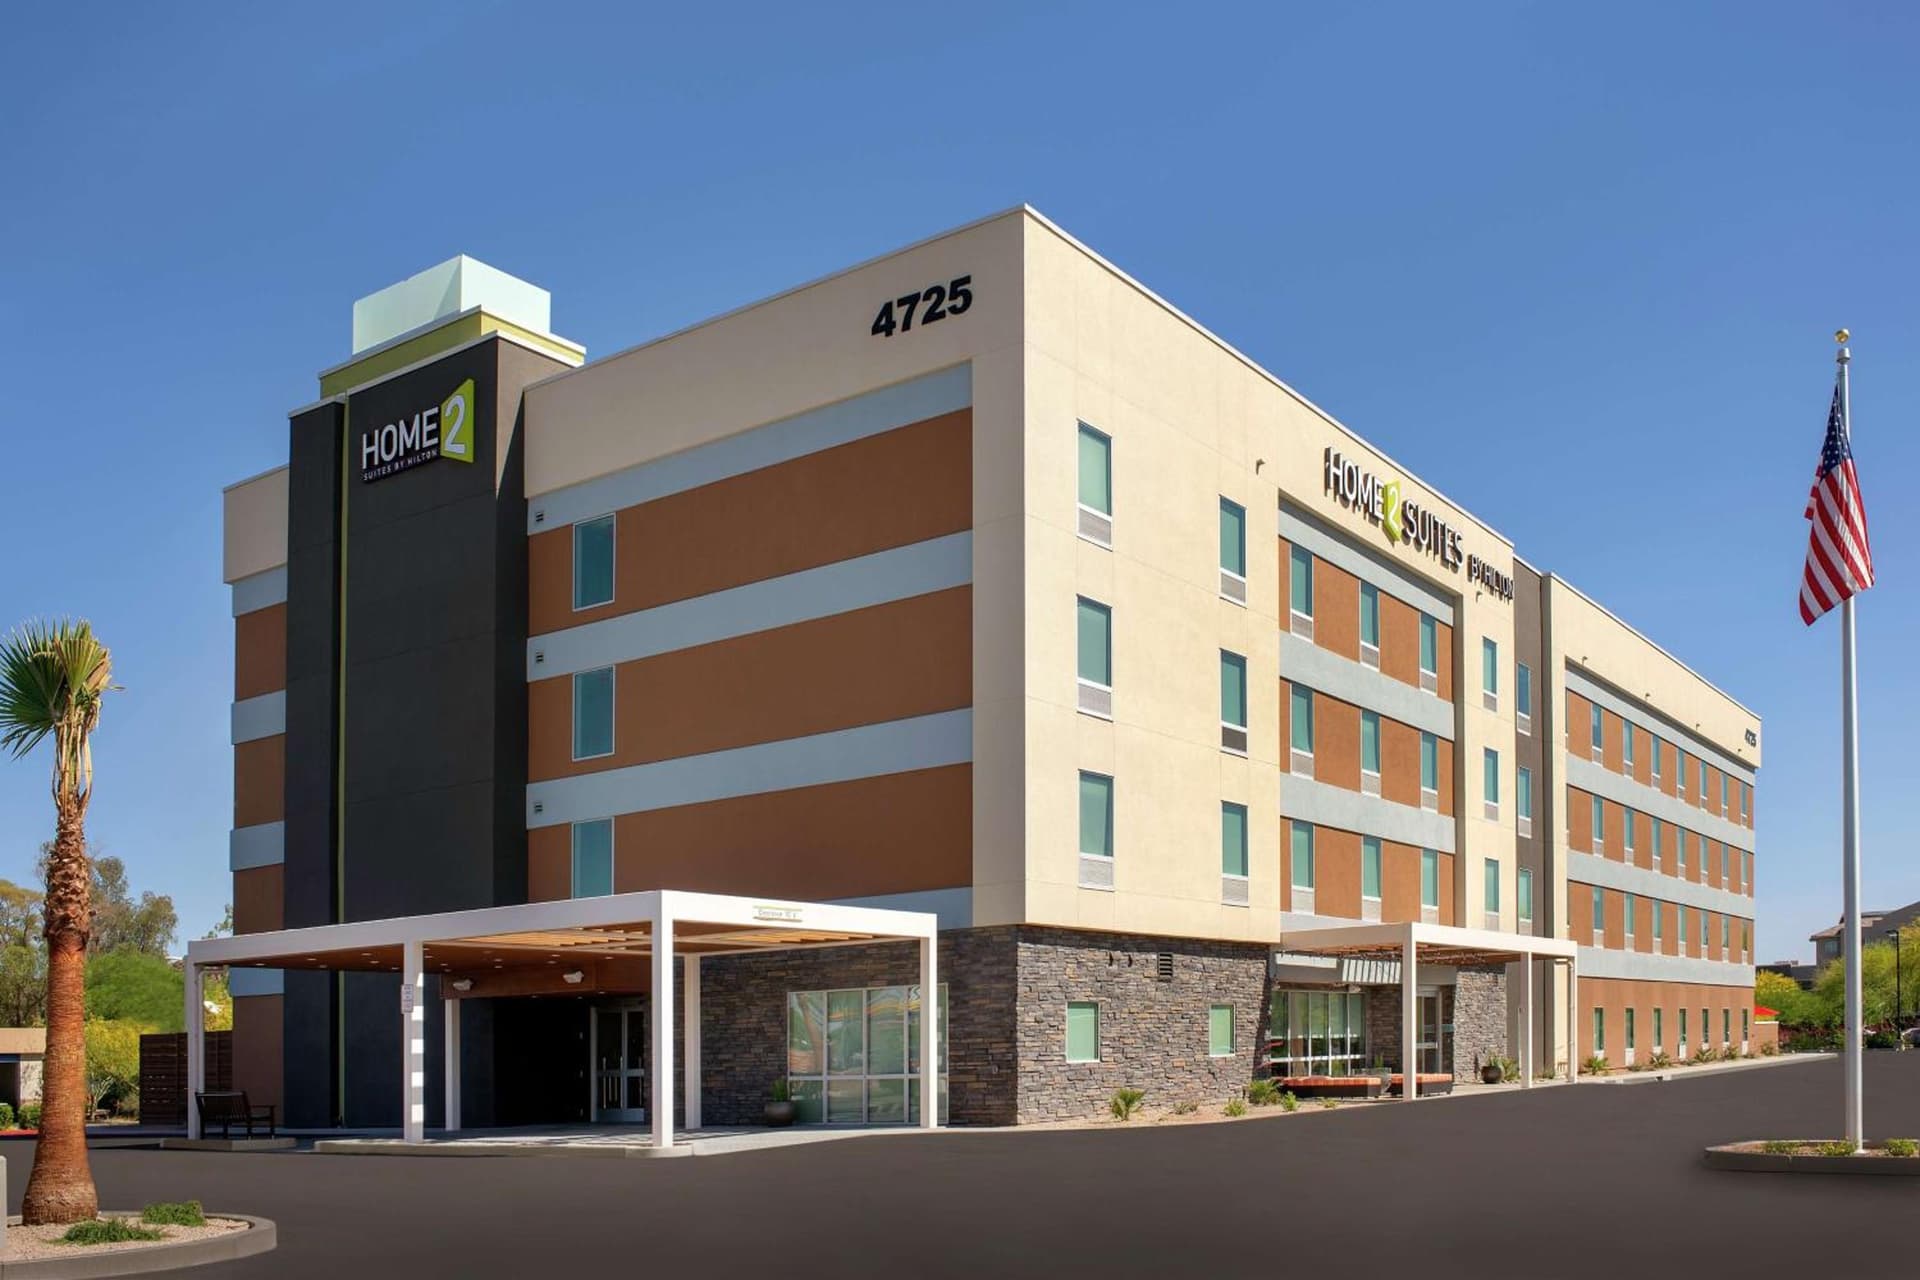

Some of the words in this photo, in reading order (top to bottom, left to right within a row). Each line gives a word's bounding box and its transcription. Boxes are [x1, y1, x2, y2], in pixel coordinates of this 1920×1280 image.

[871, 275, 973, 337] 4725
[363, 464, 392, 481] SUITES
[394, 459, 405, 471] BY
[407, 448, 439, 466] HILTON
[1402, 498, 1464, 568] SUITES
[1470, 553, 1482, 579] BY
